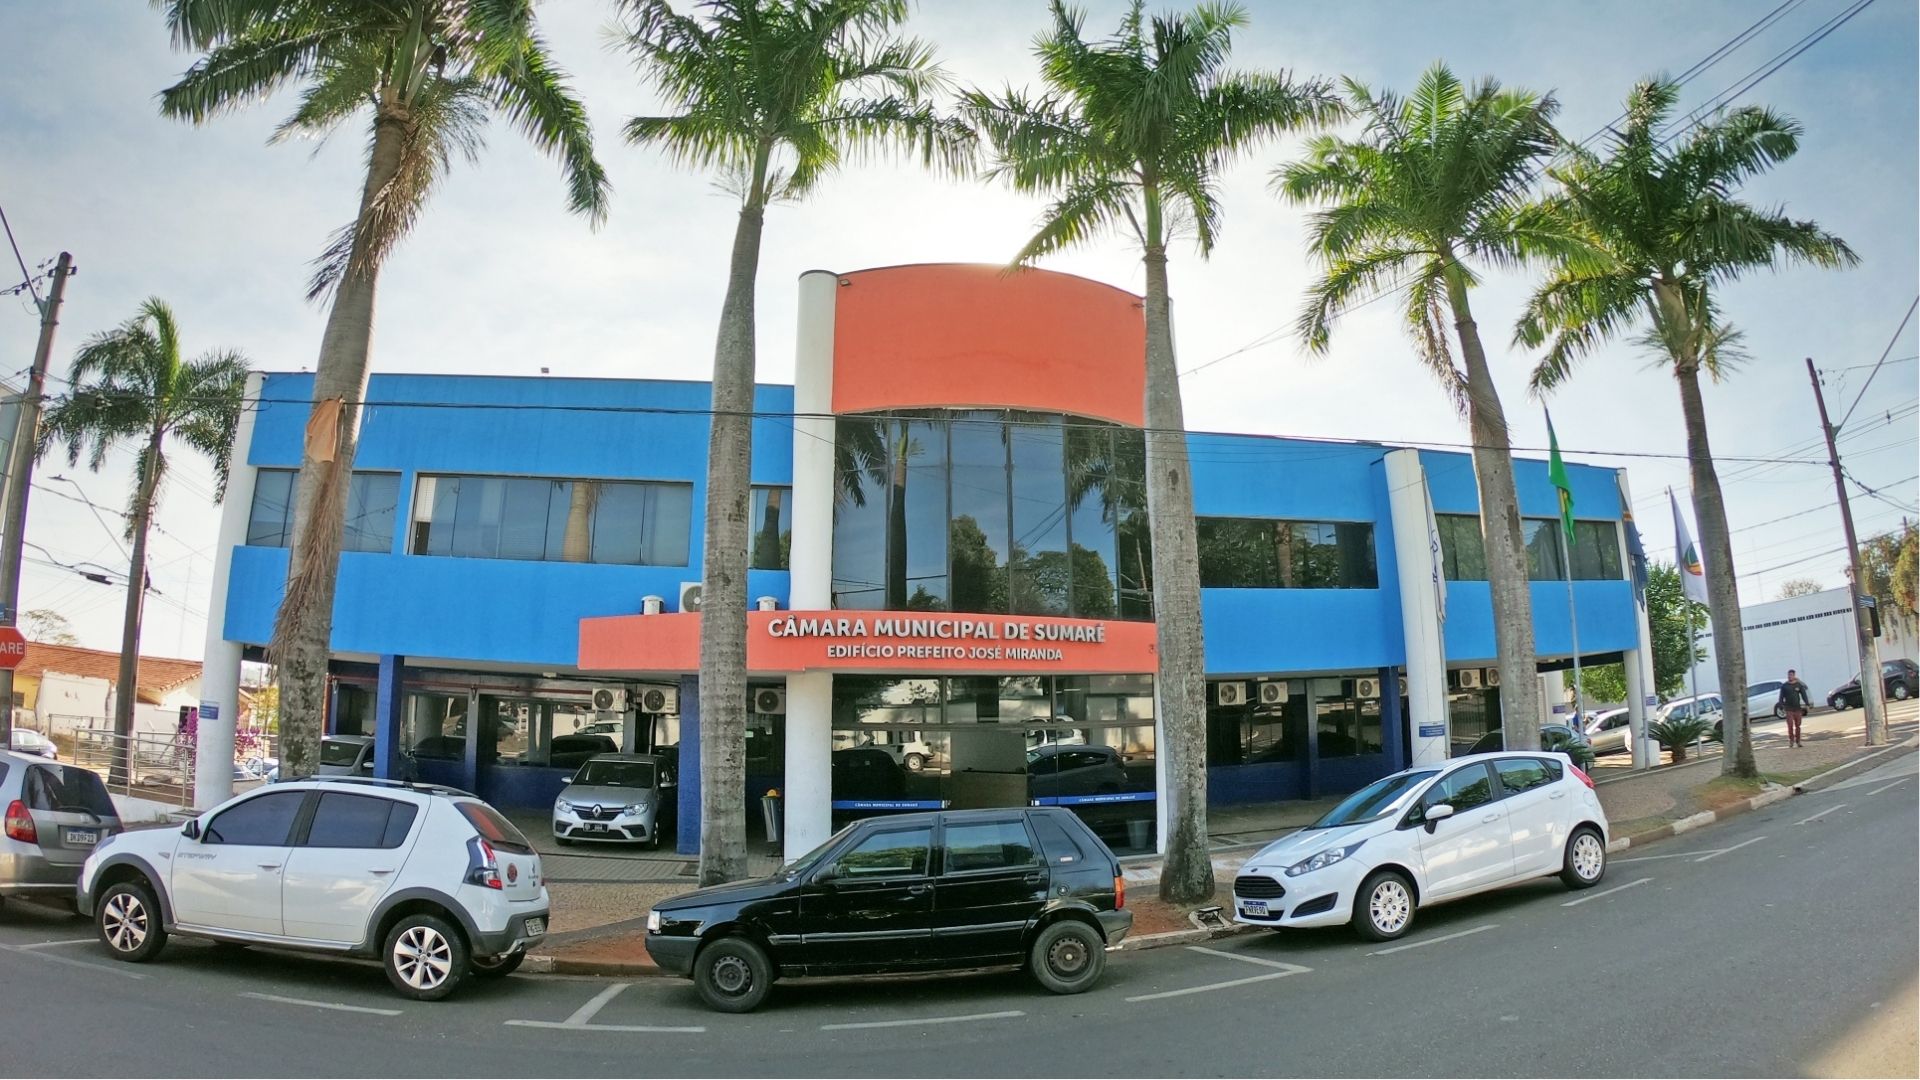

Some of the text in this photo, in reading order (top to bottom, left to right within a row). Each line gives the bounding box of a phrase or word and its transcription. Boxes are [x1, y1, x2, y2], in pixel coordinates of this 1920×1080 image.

[767, 614, 1106, 643] CÂMARA MUNICIPAL DE SUMARÉ
[0, 641, 24, 655] ARE
[827, 643, 1064, 661] EDIFÍCIO PREFEITO JOSÉ MIRANDA
